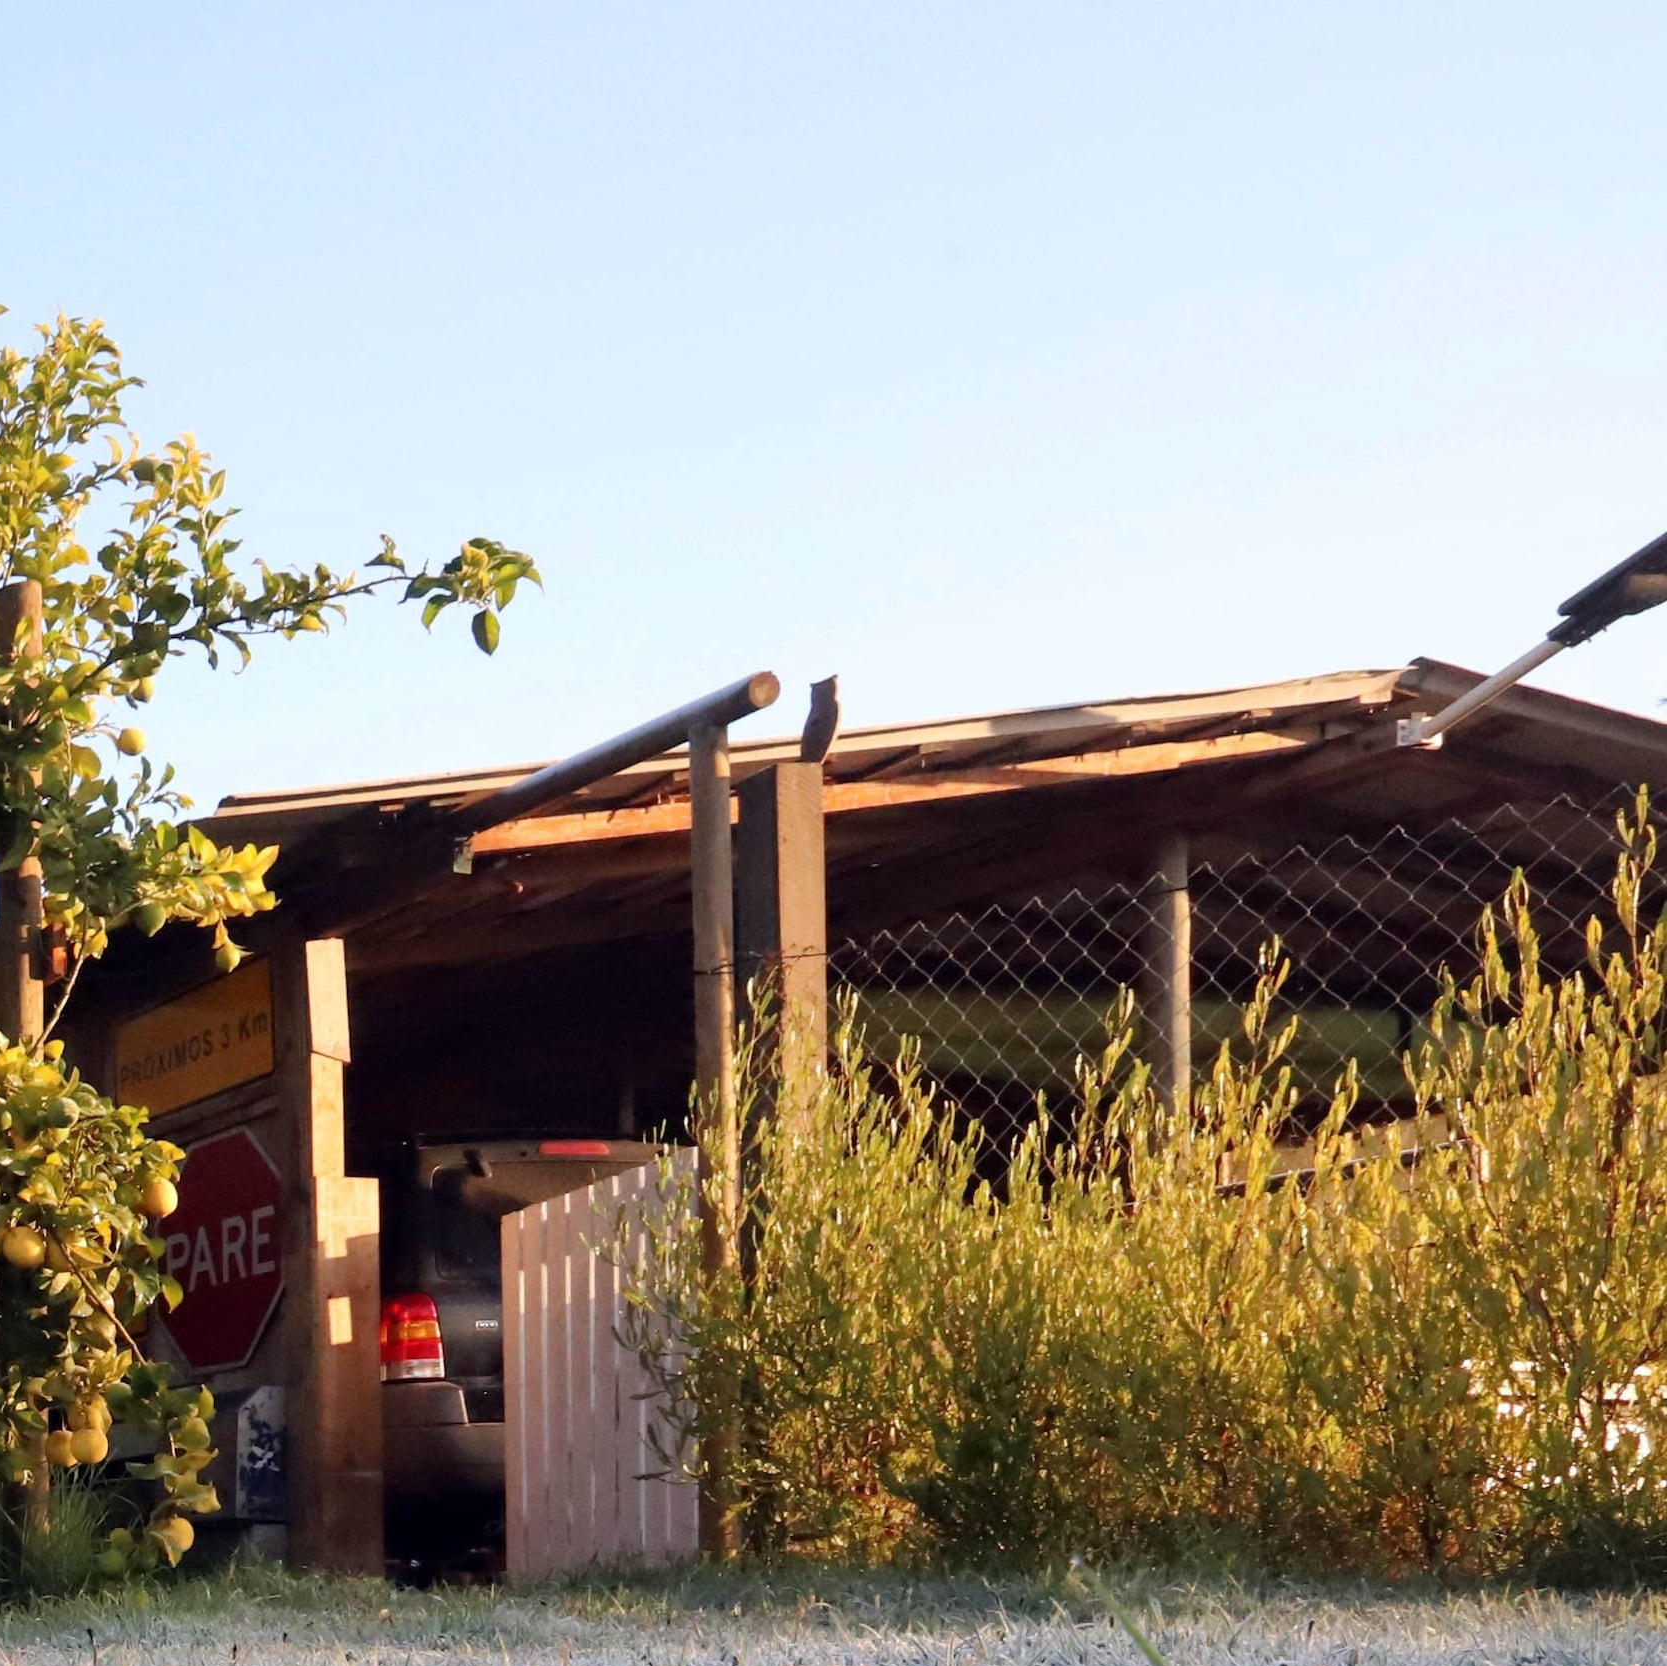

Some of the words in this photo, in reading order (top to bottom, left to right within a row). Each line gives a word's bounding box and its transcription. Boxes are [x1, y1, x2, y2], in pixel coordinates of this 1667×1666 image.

[221, 1023, 230, 1049] 3
[238, 1010, 268, 1042] Km
[167, 1205, 275, 1292] PARE
